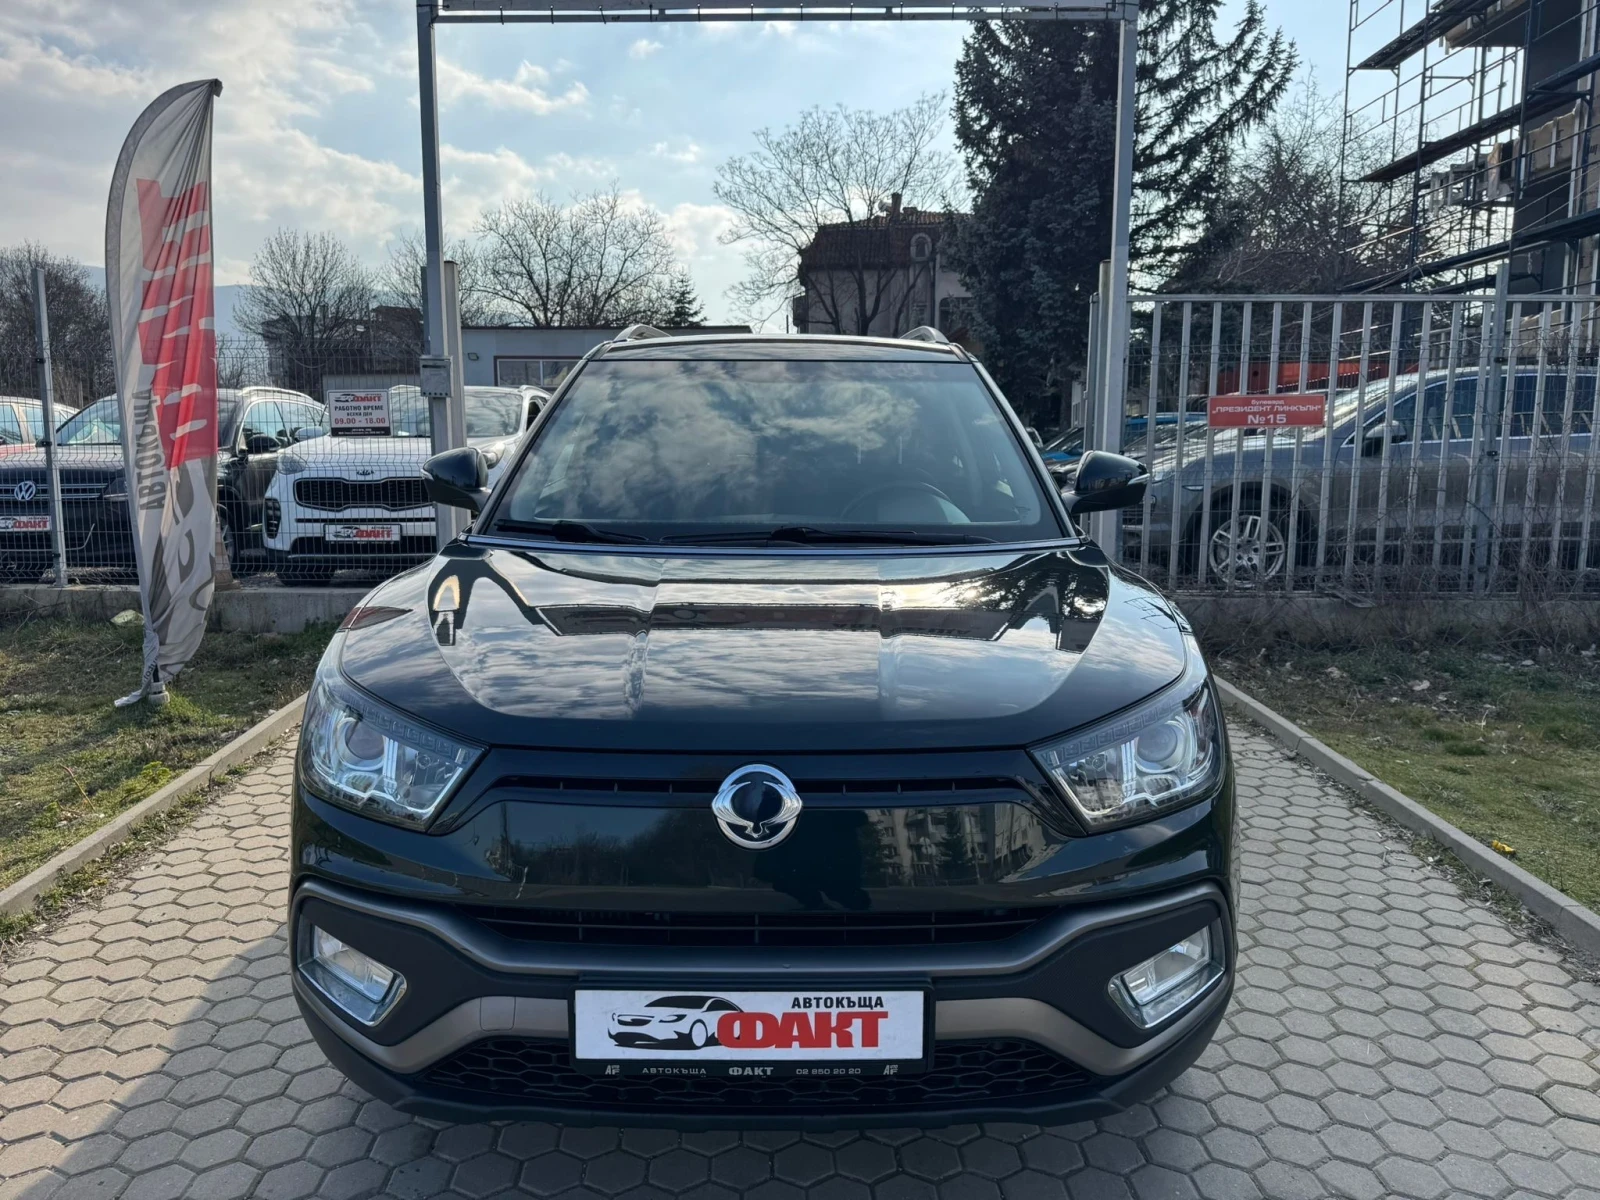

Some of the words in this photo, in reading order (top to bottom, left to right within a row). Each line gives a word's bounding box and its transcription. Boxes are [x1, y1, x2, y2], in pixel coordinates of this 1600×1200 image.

[334, 417, 356, 425] 09.00
[1247, 414, 1287, 425] №15
[791, 996, 884, 1010] АВТОКЪЩА
[717, 1011, 888, 1049] ФАКТ
[728, 1066, 774, 1076] ФАКТ
[848, 1067, 861, 1075] 20
